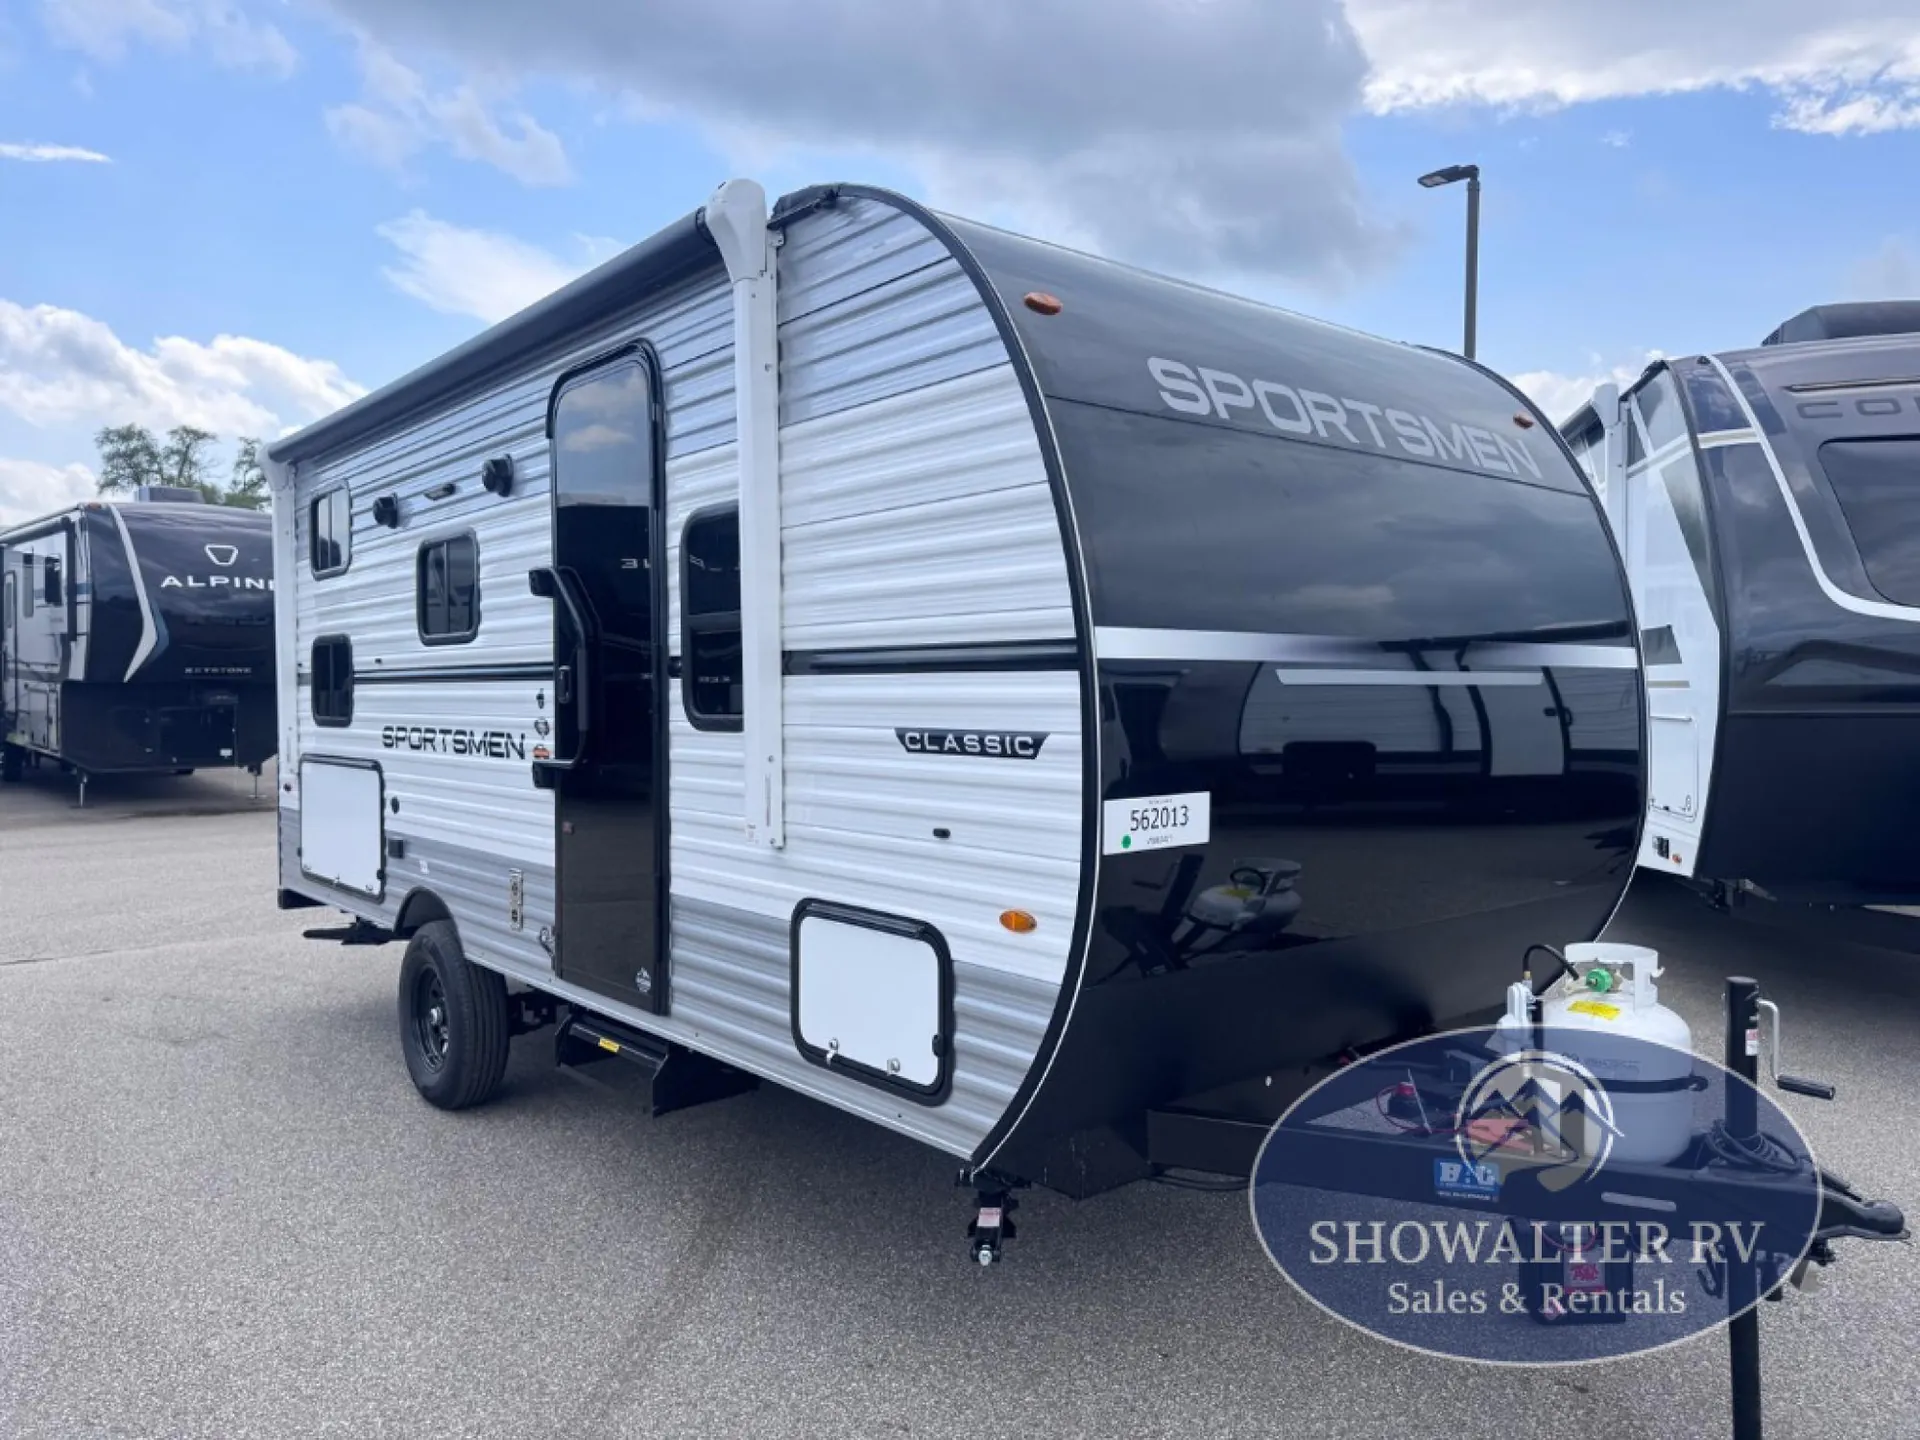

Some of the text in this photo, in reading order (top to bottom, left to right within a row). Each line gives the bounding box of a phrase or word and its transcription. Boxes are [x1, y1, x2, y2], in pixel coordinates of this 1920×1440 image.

[1147, 356, 1542, 479] SPORTSMEN
[1796, 397, 1920, 419] CO
[382, 726, 525, 760] SPORTSMEN
[904, 732, 1034, 755] CLASSIC
[1130, 804, 1190, 832] 562013
